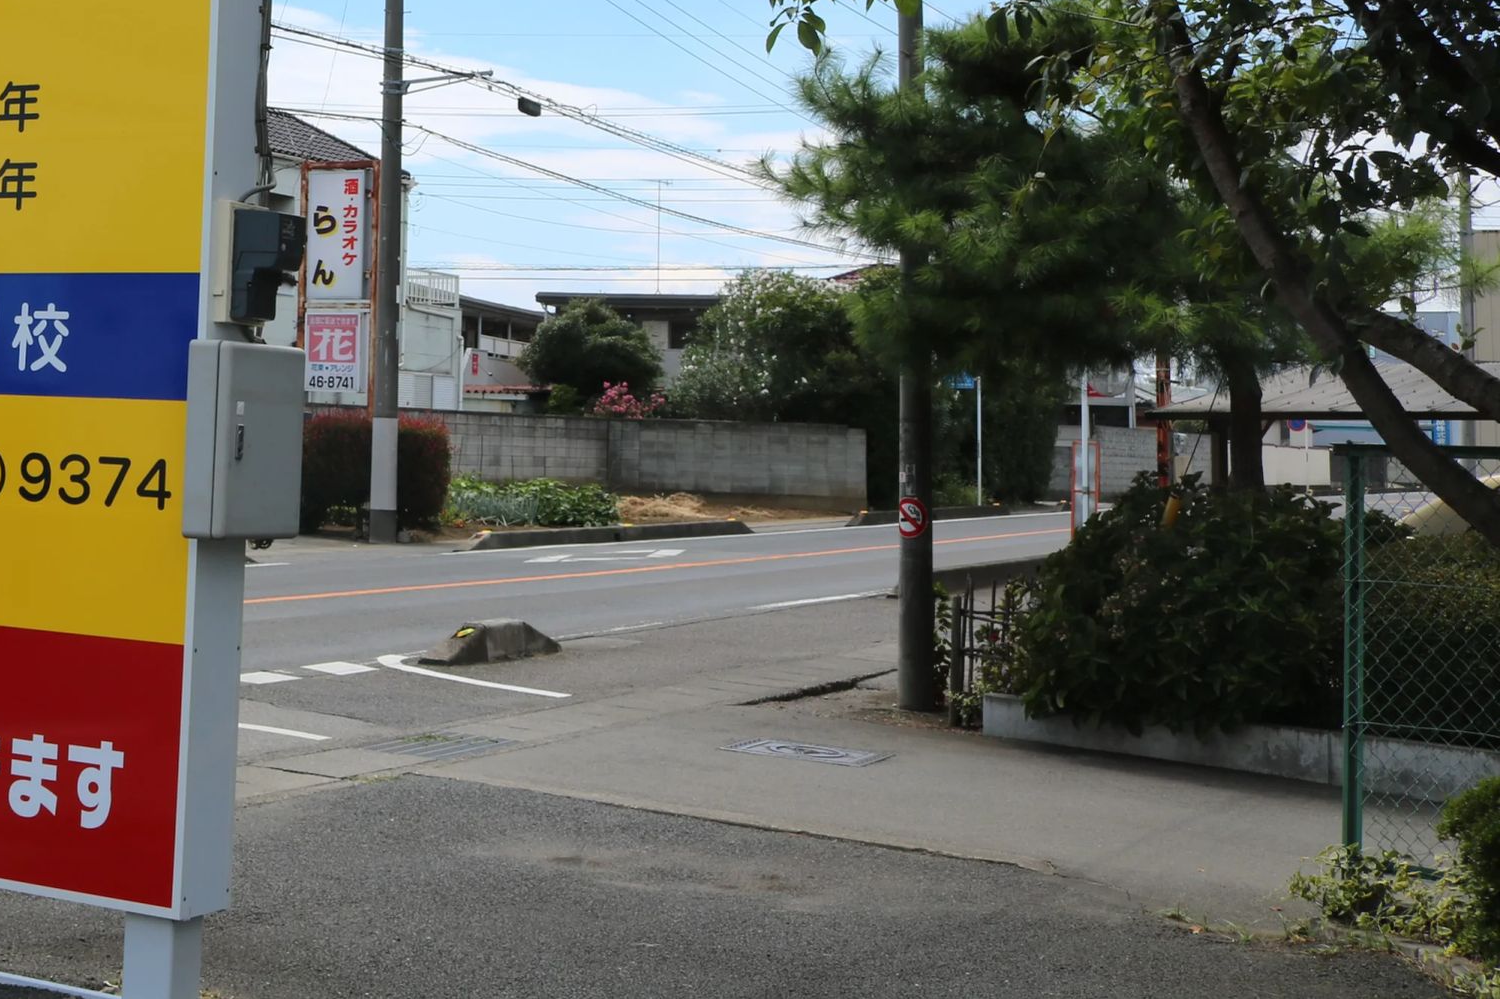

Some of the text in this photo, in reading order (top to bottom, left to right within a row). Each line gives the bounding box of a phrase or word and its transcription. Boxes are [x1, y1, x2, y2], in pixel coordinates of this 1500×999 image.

[311, 205, 338, 287] らん
[311, 328, 354, 361] 花
[309, 375, 354, 389] 46-8741
